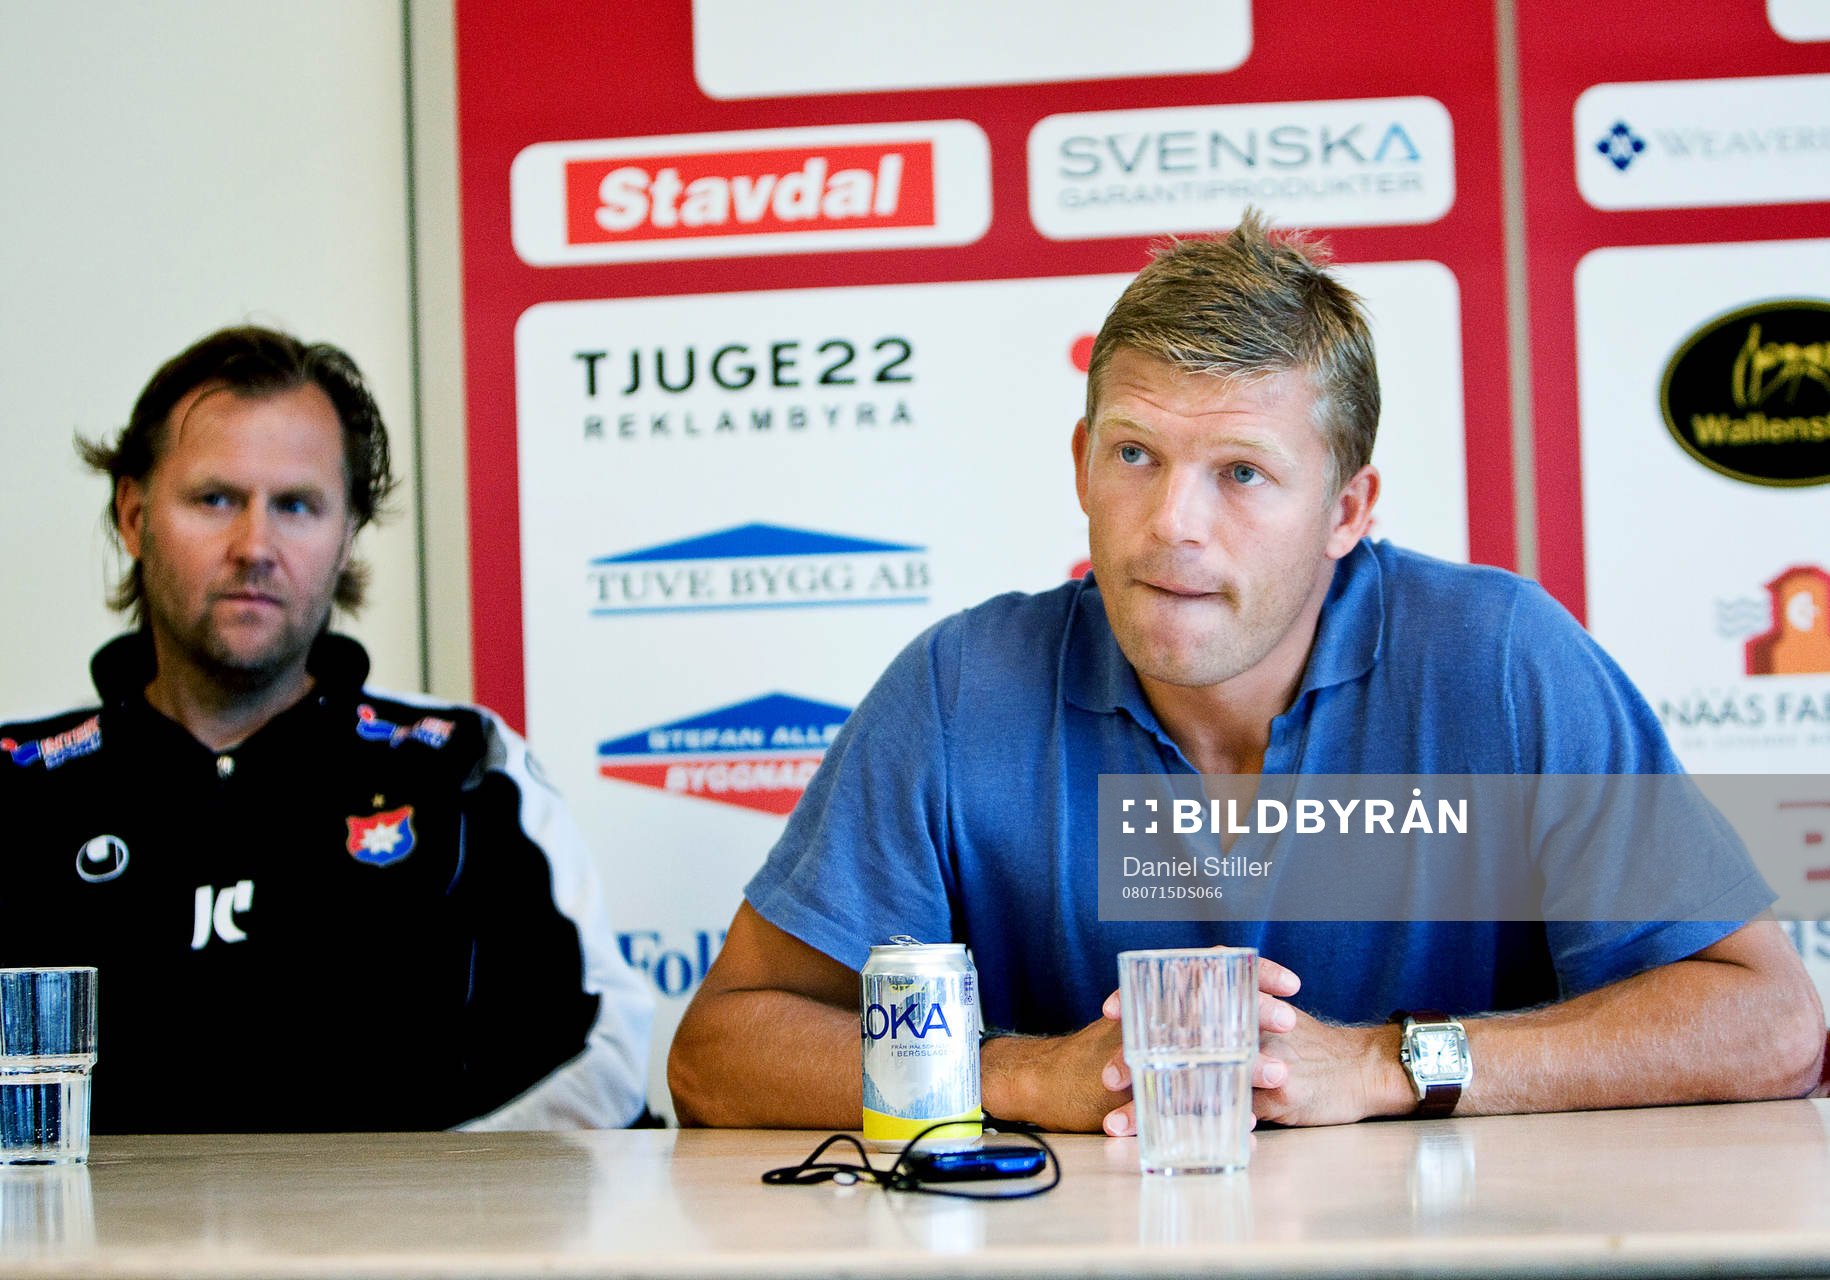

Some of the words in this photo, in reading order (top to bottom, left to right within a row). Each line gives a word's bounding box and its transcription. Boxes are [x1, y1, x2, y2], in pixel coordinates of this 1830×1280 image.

[1059, 122, 1421, 178] SVENSKA
[595, 152, 902, 232] Stavdal
[1059, 171, 1424, 209] GARANTIPRODUKTER
[574, 337, 913, 396] TJUGE22
[1692, 412, 1830, 447] Wallens
[588, 566, 715, 602] TUVE
[730, 562, 853, 597] BYGG
[870, 558, 930, 591] AB
[649, 727, 764, 749] STEFAN
[191, 880, 254, 950] JC
[615, 930, 727, 997] Fol
